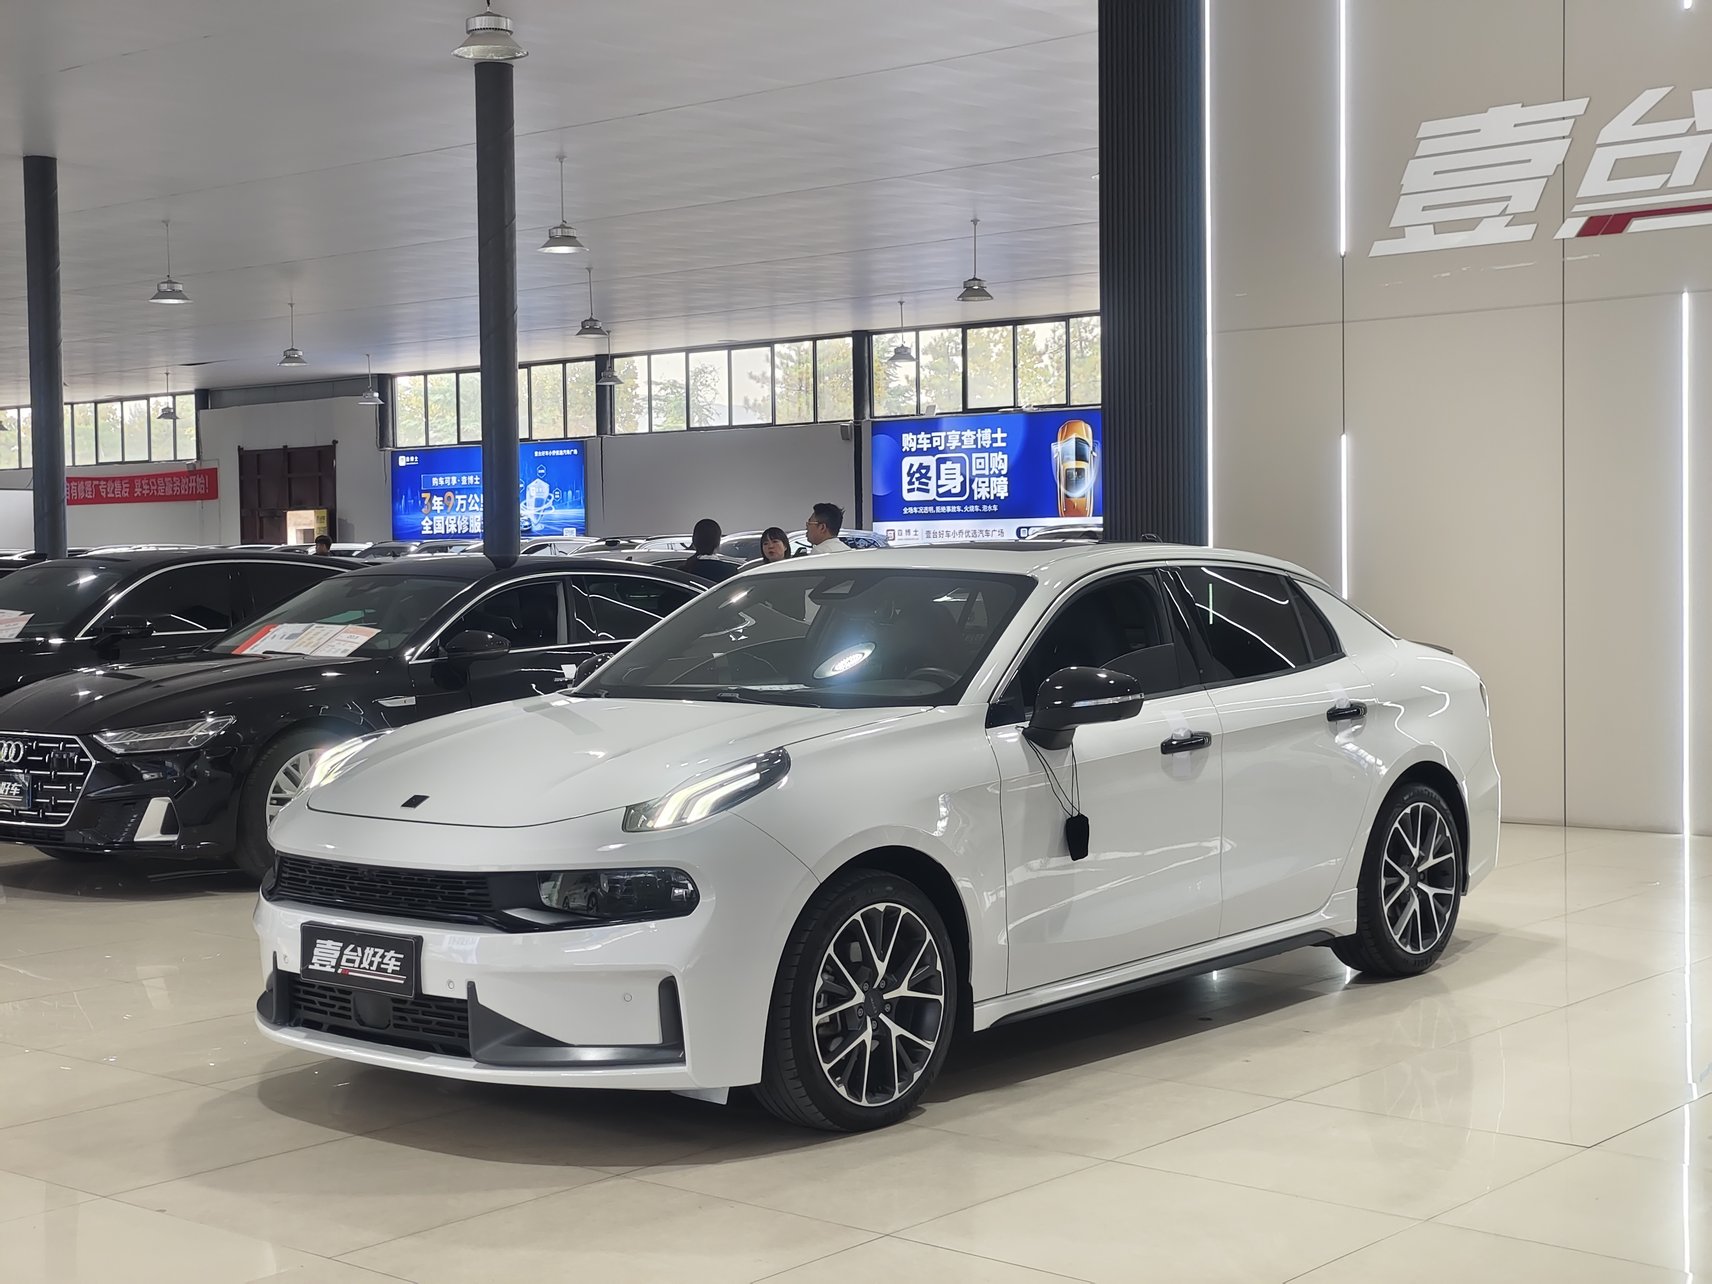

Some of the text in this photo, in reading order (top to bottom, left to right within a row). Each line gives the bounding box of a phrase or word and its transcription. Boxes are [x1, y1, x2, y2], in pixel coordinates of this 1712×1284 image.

[902, 428, 1007, 452] 购车可享查博士
[971, 452, 1008, 476] 回购
[906, 461, 964, 495] 终身
[972, 477, 1009, 501] 保障
[421, 491, 484, 515] 3年9万公
[420, 515, 484, 535] 全国保修服
[308, 939, 405, 973] 壹台好车
